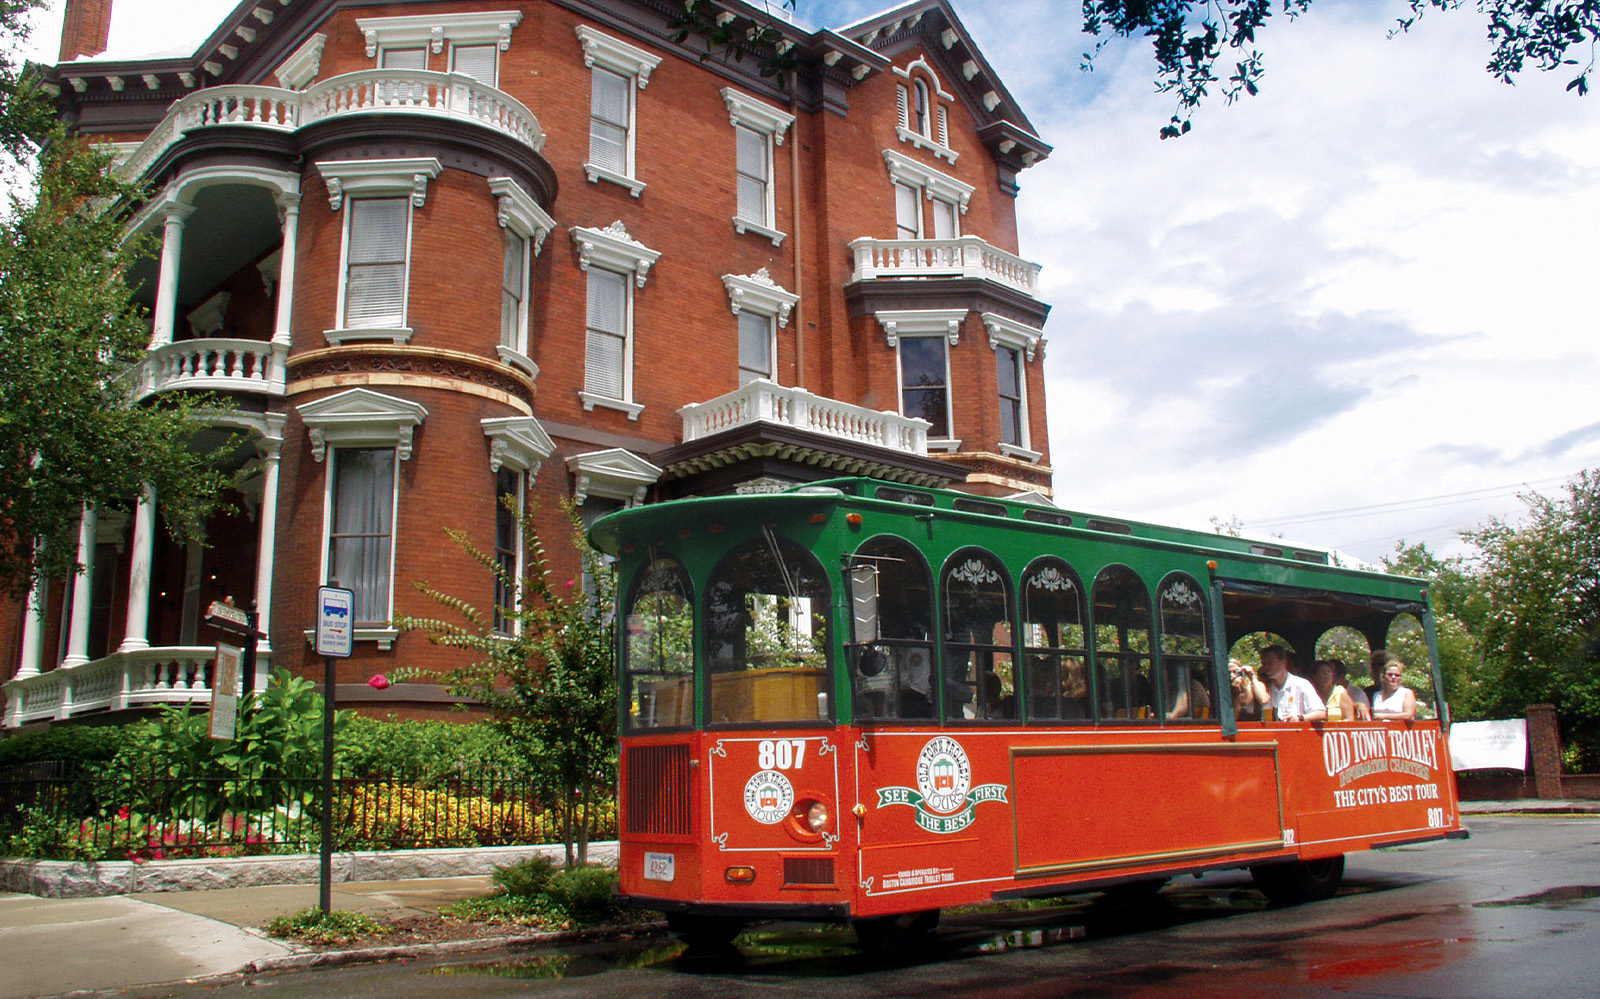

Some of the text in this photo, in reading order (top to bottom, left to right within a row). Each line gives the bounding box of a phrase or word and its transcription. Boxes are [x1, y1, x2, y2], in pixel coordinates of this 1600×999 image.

[758, 740, 806, 770] 807
[919, 740, 969, 783] OLD TOWN TROLLEY
[1323, 730, 1439, 777] OLD TOWN TROLLEY
[746, 773, 791, 802] OLD TOWN TROLLEY
[884, 789, 909, 803] SEE
[927, 787, 964, 810] TOURS
[974, 785, 1003, 801] FIRST
[1333, 783, 1439, 808] THE CITY'S BEST TOUR
[753, 805, 786, 821] TOURS
[919, 810, 972, 831] THE BEST
[1427, 807, 1443, 828] 807
[883, 879, 899, 888] BOSTON
[924, 875, 941, 883] TROLLEY
[942, 873, 954, 881] TOURS
